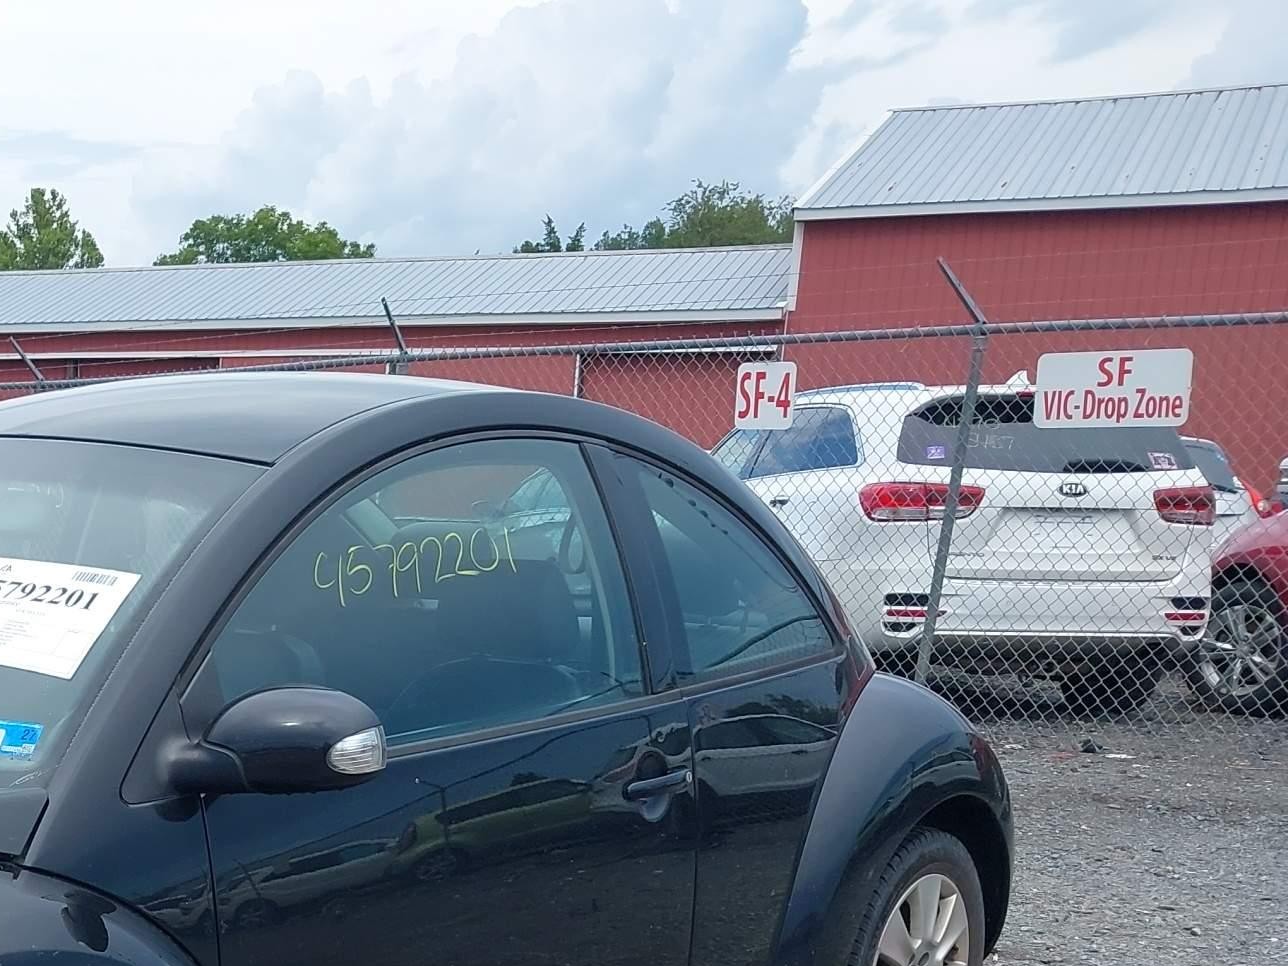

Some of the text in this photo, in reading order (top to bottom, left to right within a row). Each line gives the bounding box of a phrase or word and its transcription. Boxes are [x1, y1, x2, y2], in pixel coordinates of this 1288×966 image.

[1096, 356, 1134, 387] SF
[738, 371, 791, 419] SF-4
[1043, 388, 1183, 424] VIC-Drop Zone
[1061, 484, 1086, 495] KIA
[314, 527, 517, 607] 45792201
